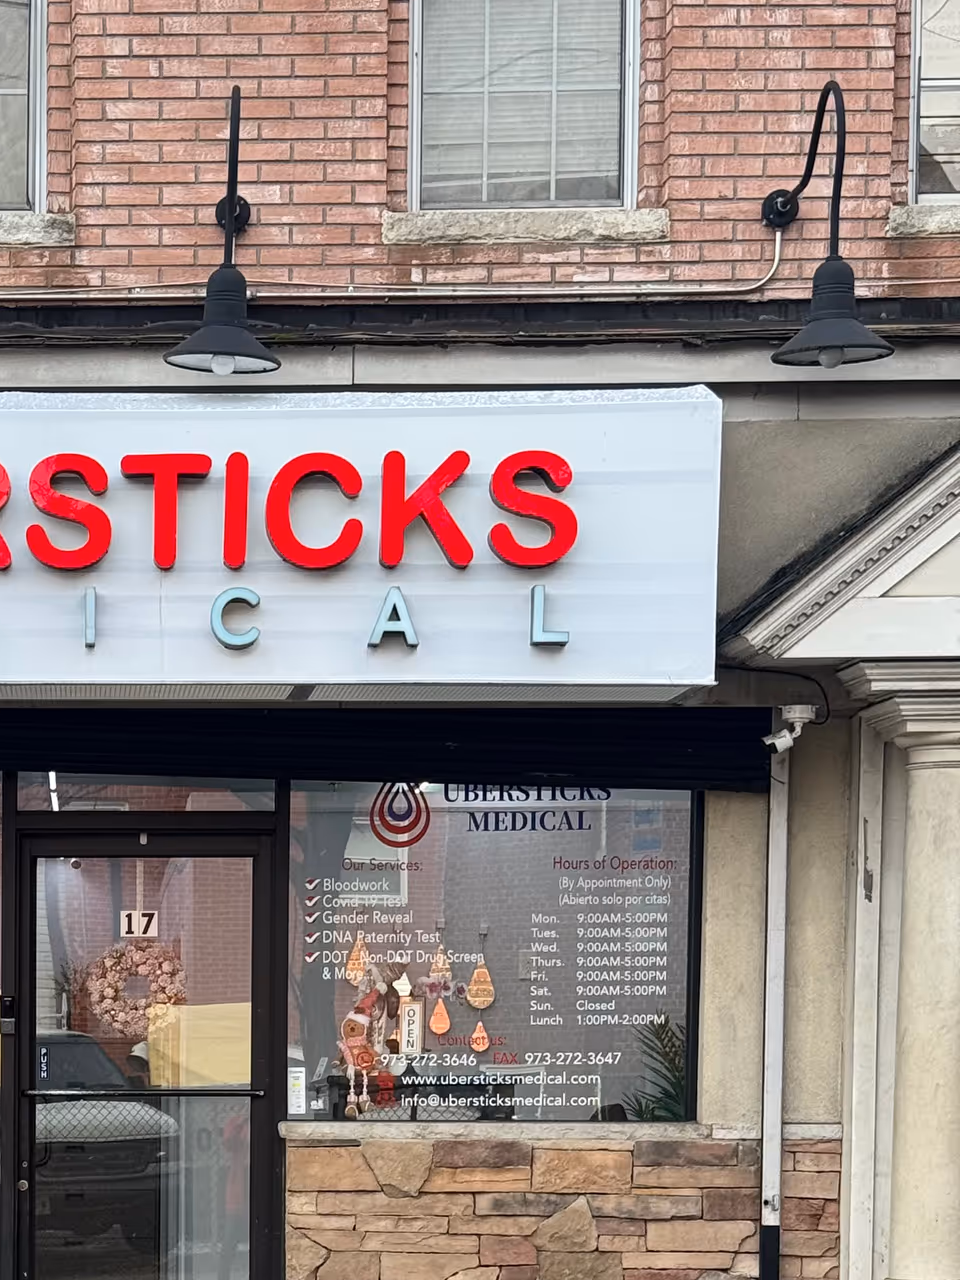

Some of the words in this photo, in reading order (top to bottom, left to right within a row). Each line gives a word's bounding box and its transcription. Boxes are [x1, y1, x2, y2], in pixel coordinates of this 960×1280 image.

[444, 783, 611, 802] UBERSTICKS
[466, 811, 592, 832] MEDICAL
[342, 858, 364, 870] Our
[370, 858, 423, 871] Services:
[553, 857, 589, 870] Hours
[593, 856, 606, 870] of
[610, 856, 677, 874] Operation:
[323, 878, 389, 891] Bloodwork
[558, 876, 575, 890] (By
[577, 876, 642, 891] Appointment
[645, 876, 671, 890] Only)
[382, 895, 407, 907] Test
[558, 893, 599, 907] (Abierto
[602, 893, 623, 905] solo
[625, 894, 641, 908] por
[645, 893, 671, 906] citas)
[125, 912, 156, 935] 17
[323, 911, 369, 923] Gender
[373, 911, 413, 923] Reveal
[531, 913, 560, 923] Mon.
[577, 913, 668, 923] 9:00AM-5:00PM
[323, 931, 353, 943] DNA
[357, 930, 412, 946] Paternity
[415, 930, 440, 943] Test
[531, 928, 559, 938] Tues.
[577, 927, 668, 938] 9:00AM-5:00PM
[531, 942, 559, 952] Wed.
[576, 942, 668, 952] 9:00AM-5:00PM
[323, 951, 348, 963] DOT
[360, 951, 413, 963] Non-DOT
[530, 956, 565, 967] Thurs.
[576, 956, 667, 967] 9:00AM-5:00PM
[323, 967, 332, 980] &
[530, 971, 548, 981] Fri.
[576, 971, 667, 981] 9:00AM-5:00PM
[530, 986, 551, 996] Sat.
[576, 986, 667, 996] 9:00AM-5:00PM
[530, 1000, 554, 1010] Sun.
[576, 1000, 615, 1010] Closed
[530, 1015, 563, 1025] Lunch
[576, 1015, 665, 1025] 1:00PM-2:00PM
[407, 1009, 416, 1048] OPEN
[438, 1035, 486, 1046] Contact
[491, 1036, 507, 1046] us:
[380, 1054, 477, 1066] 973-272-3646
[525, 1053, 622, 1065] 973-272-3647
[401, 1072, 600, 1085] www.ubersticksmedical.com
[401, 1094, 600, 1108] info@ubersticksmedical.com
